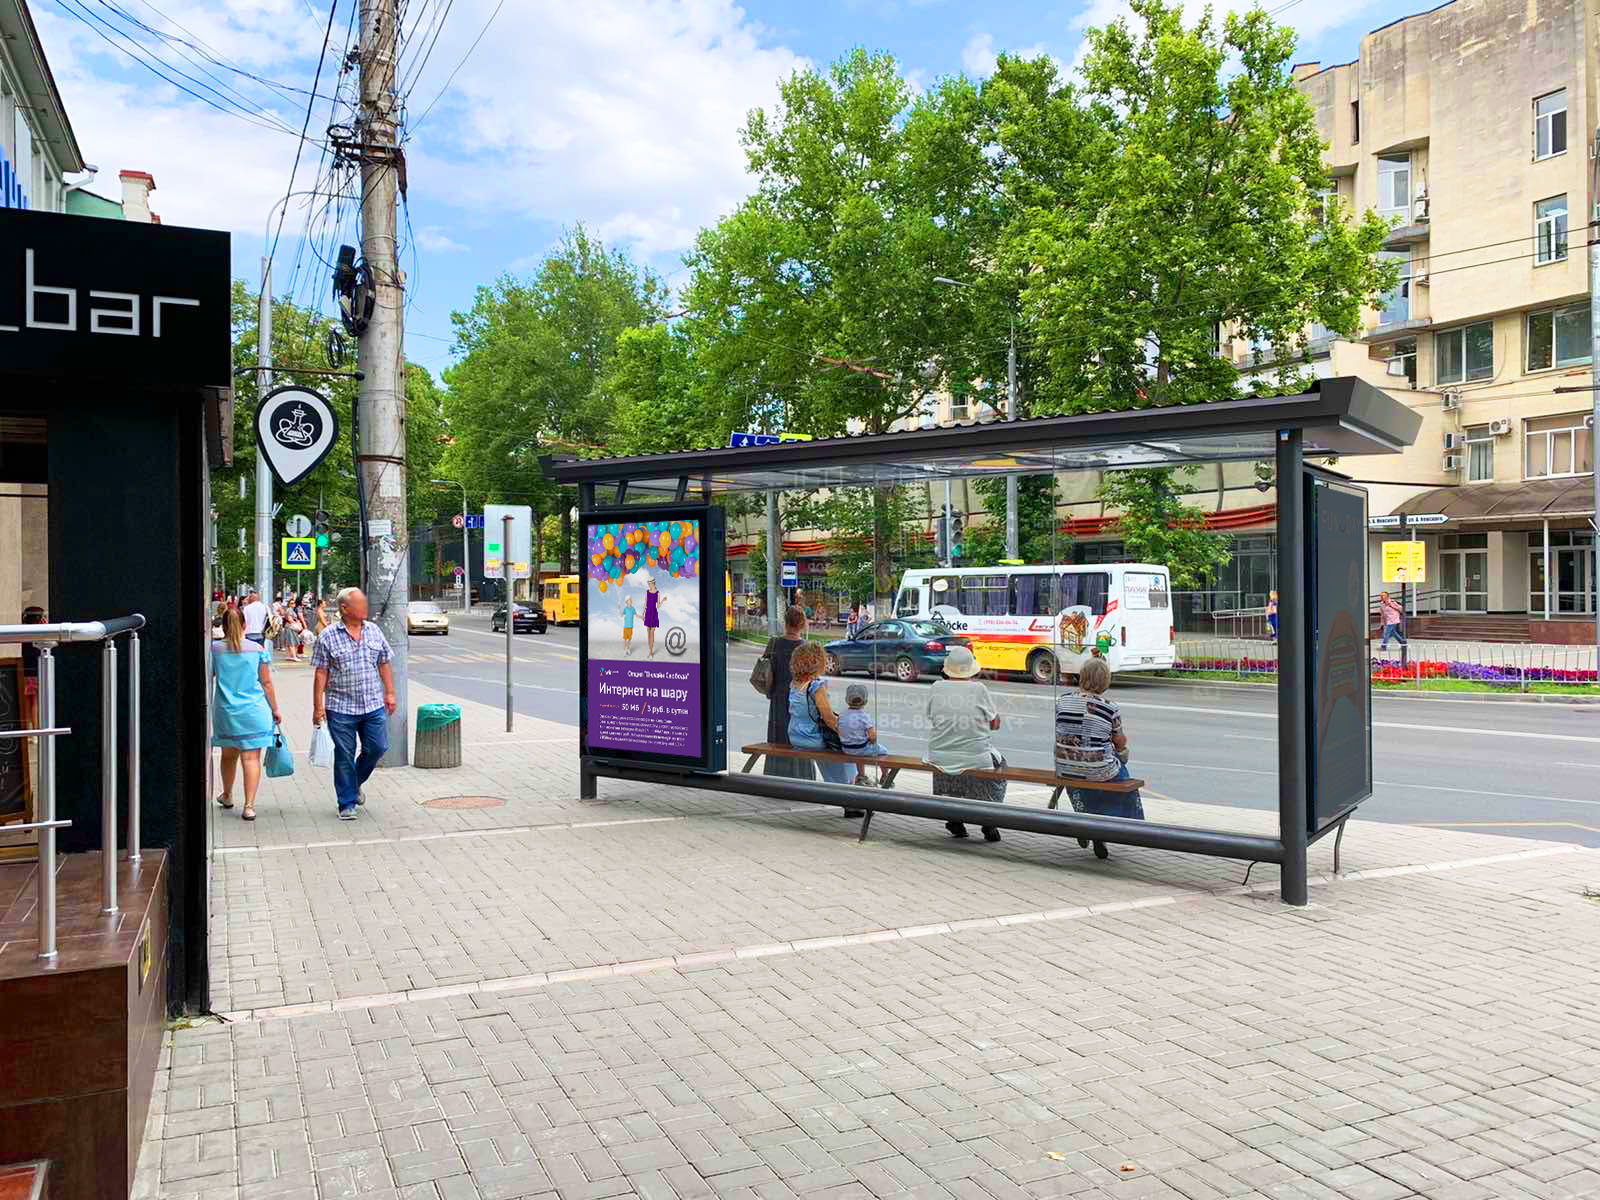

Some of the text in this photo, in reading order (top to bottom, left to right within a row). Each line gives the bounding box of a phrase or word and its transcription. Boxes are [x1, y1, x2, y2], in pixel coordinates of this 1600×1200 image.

[600, 682, 688, 702] Интернет на шару
